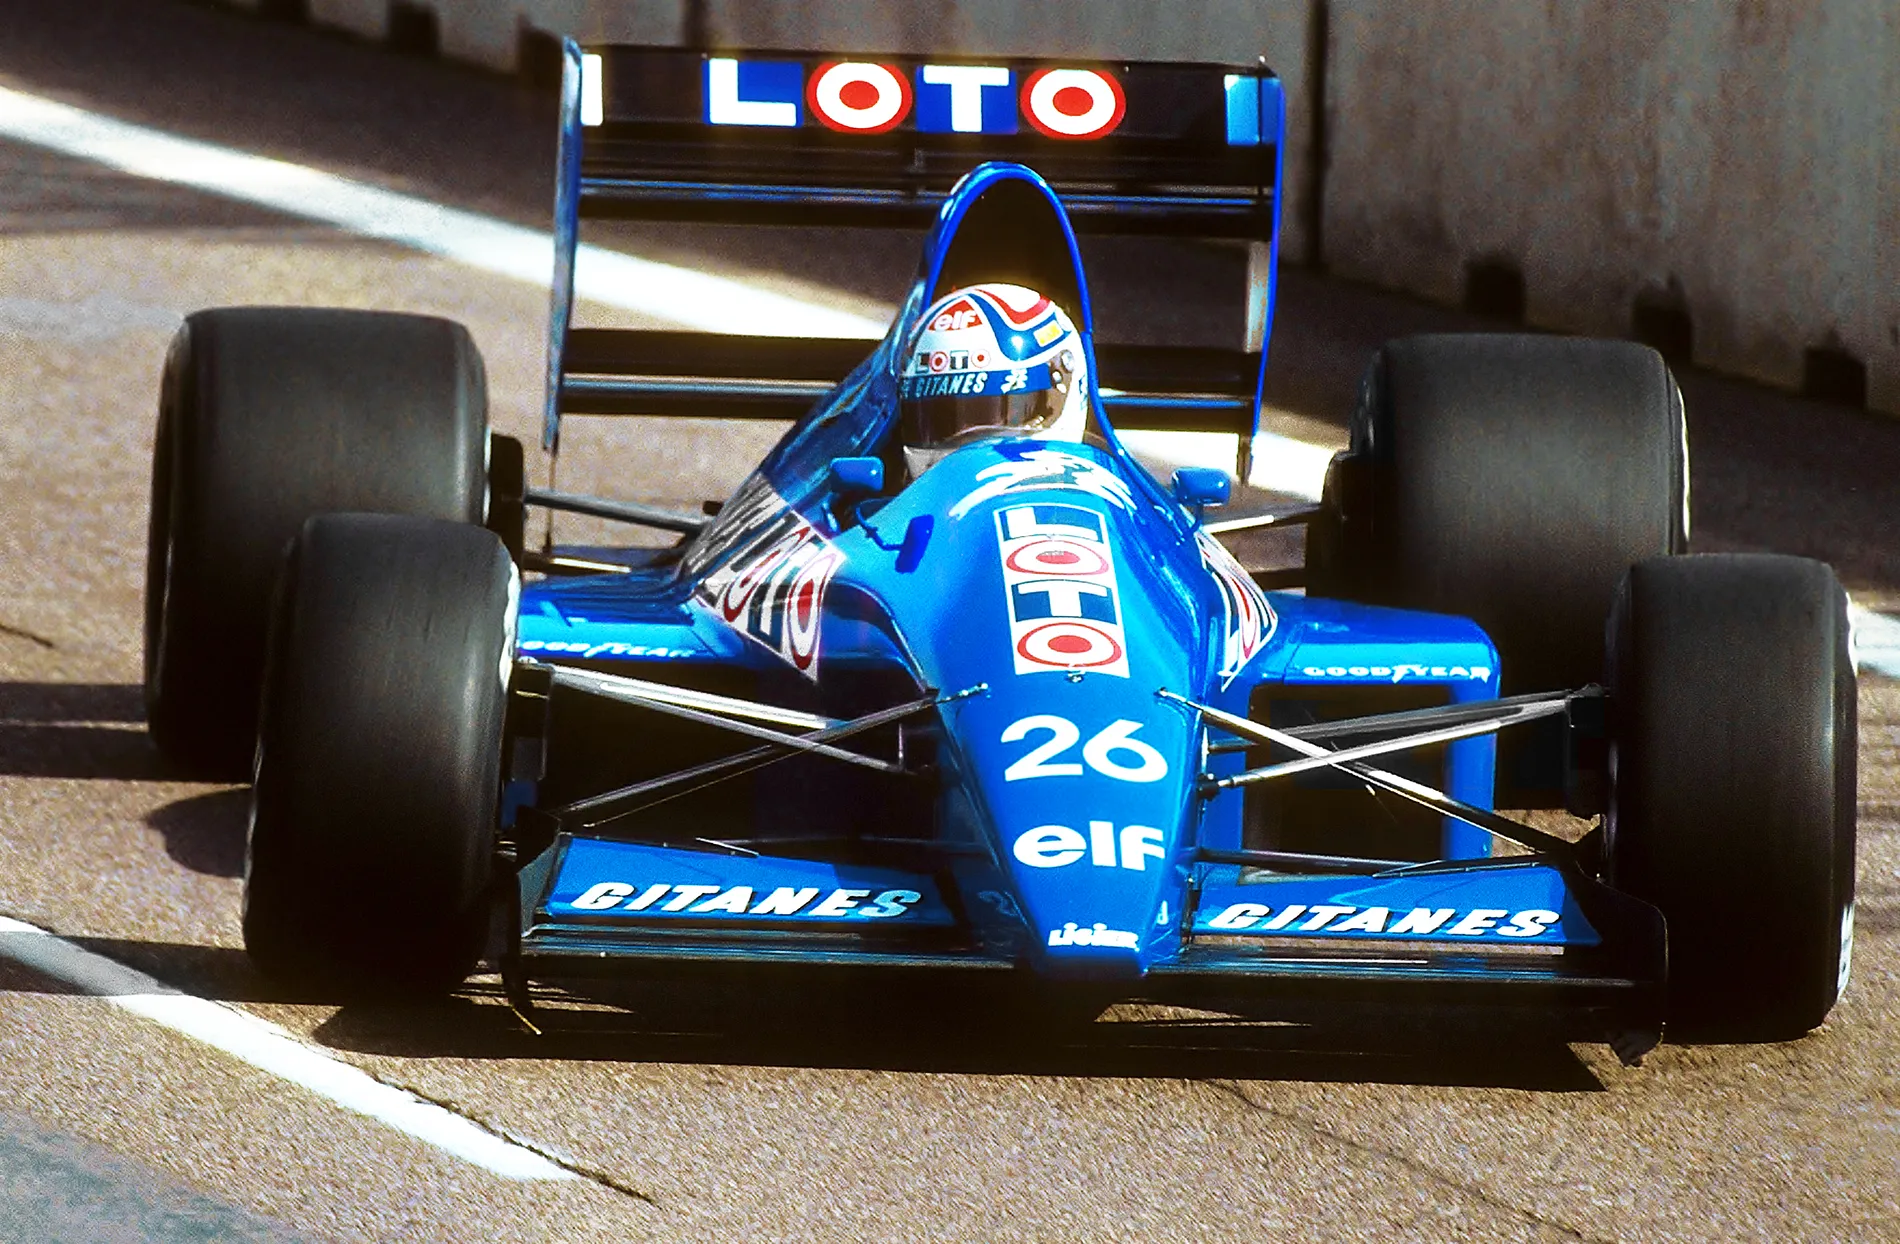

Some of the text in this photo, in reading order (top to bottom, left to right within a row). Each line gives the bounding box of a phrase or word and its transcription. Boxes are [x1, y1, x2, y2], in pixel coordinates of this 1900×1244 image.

[708, 57, 1126, 140] LOTO
[934, 310, 977, 330] elf
[915, 349, 992, 374] LOTO
[915, 371, 988, 398] GITANES
[994, 503, 1128, 675] LOTO
[1303, 664, 1491, 684] GOODYEAR
[1001, 714, 1168, 783] 26
[1013, 820, 1166, 871] elf
[571, 881, 922, 918] GITANES
[1207, 902, 1561, 938] GITANES
